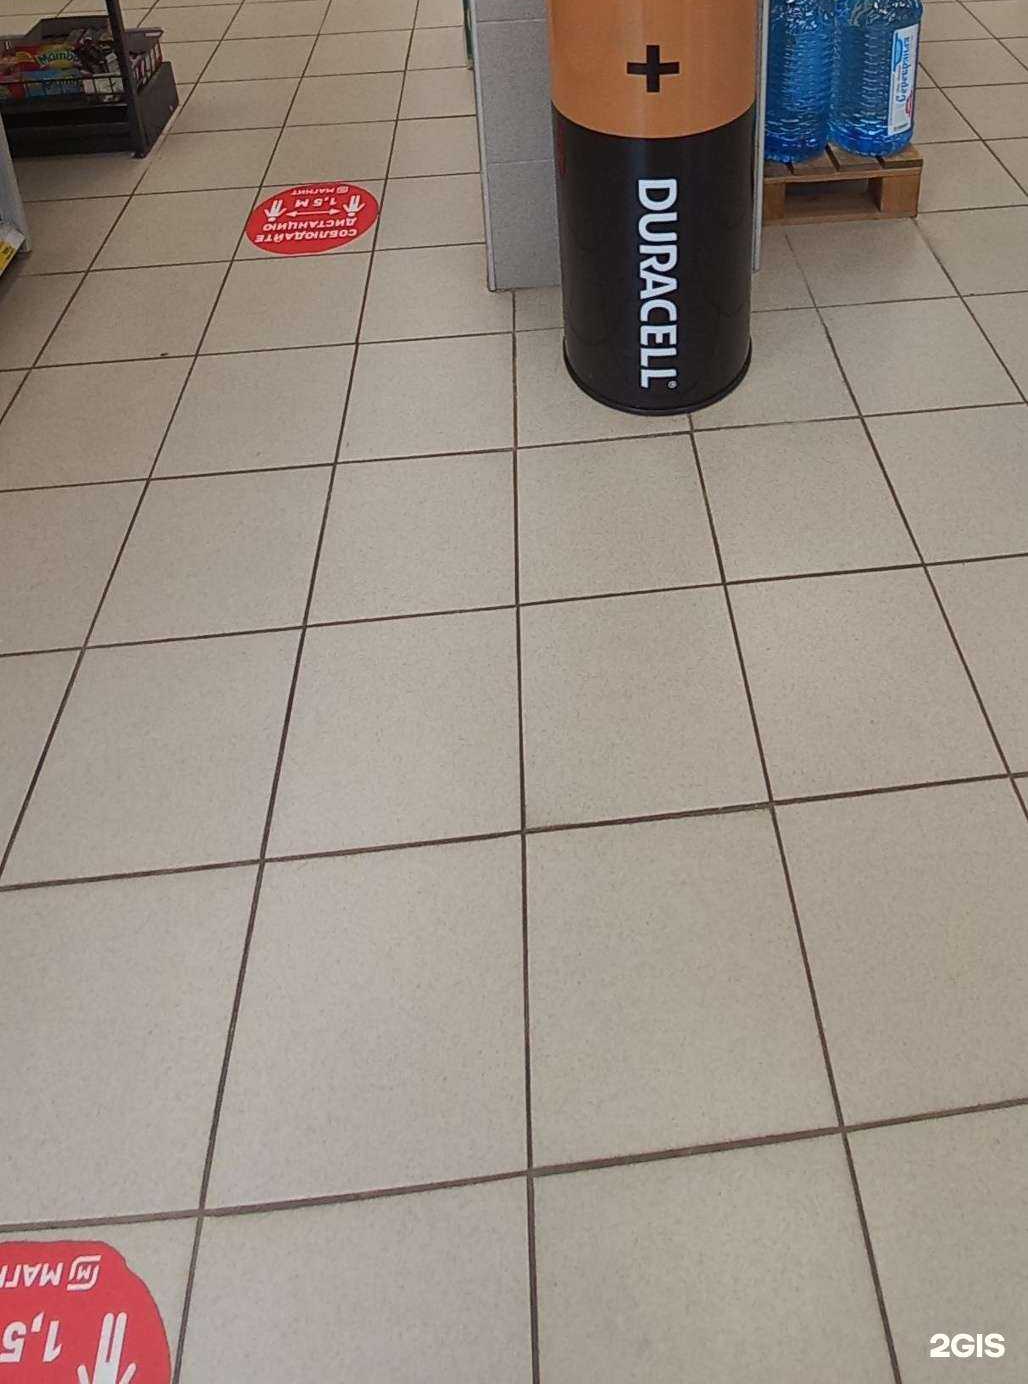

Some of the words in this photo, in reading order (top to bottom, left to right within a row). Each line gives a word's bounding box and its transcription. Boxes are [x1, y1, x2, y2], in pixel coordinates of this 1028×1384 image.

[290, 186, 335, 196] МАГНИТ
[312, 196, 337, 207] 1,5
[263, 218, 357, 232] ДИСТАНЦИЮ
[254, 229, 358, 243] СОБЛЮДАЙТЕ
